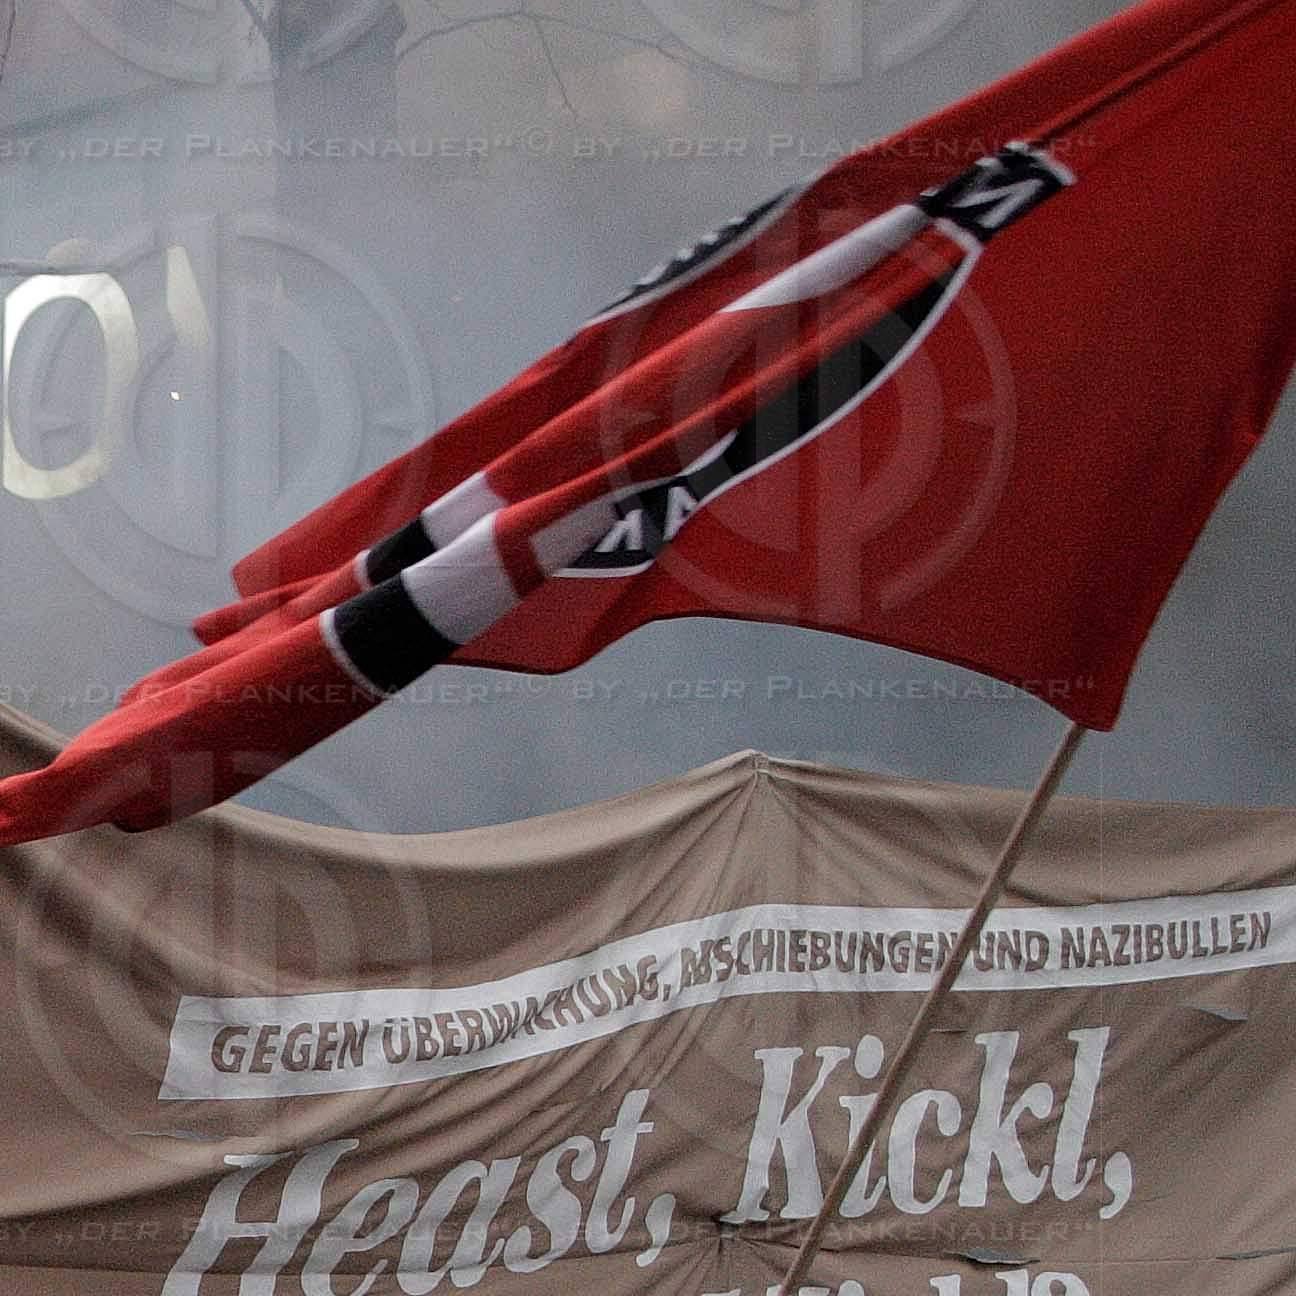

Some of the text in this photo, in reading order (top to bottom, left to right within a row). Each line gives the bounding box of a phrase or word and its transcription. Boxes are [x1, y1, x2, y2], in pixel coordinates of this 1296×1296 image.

[210, 1017, 370, 1074] GEGEN
[381, 954, 671, 1066] ÜBERWACHUNG,
[971, 928, 1052, 973] UND
[1058, 910, 1272, 970] NAZIBULLEN
[719, 1025, 1135, 1225] Kickl,
